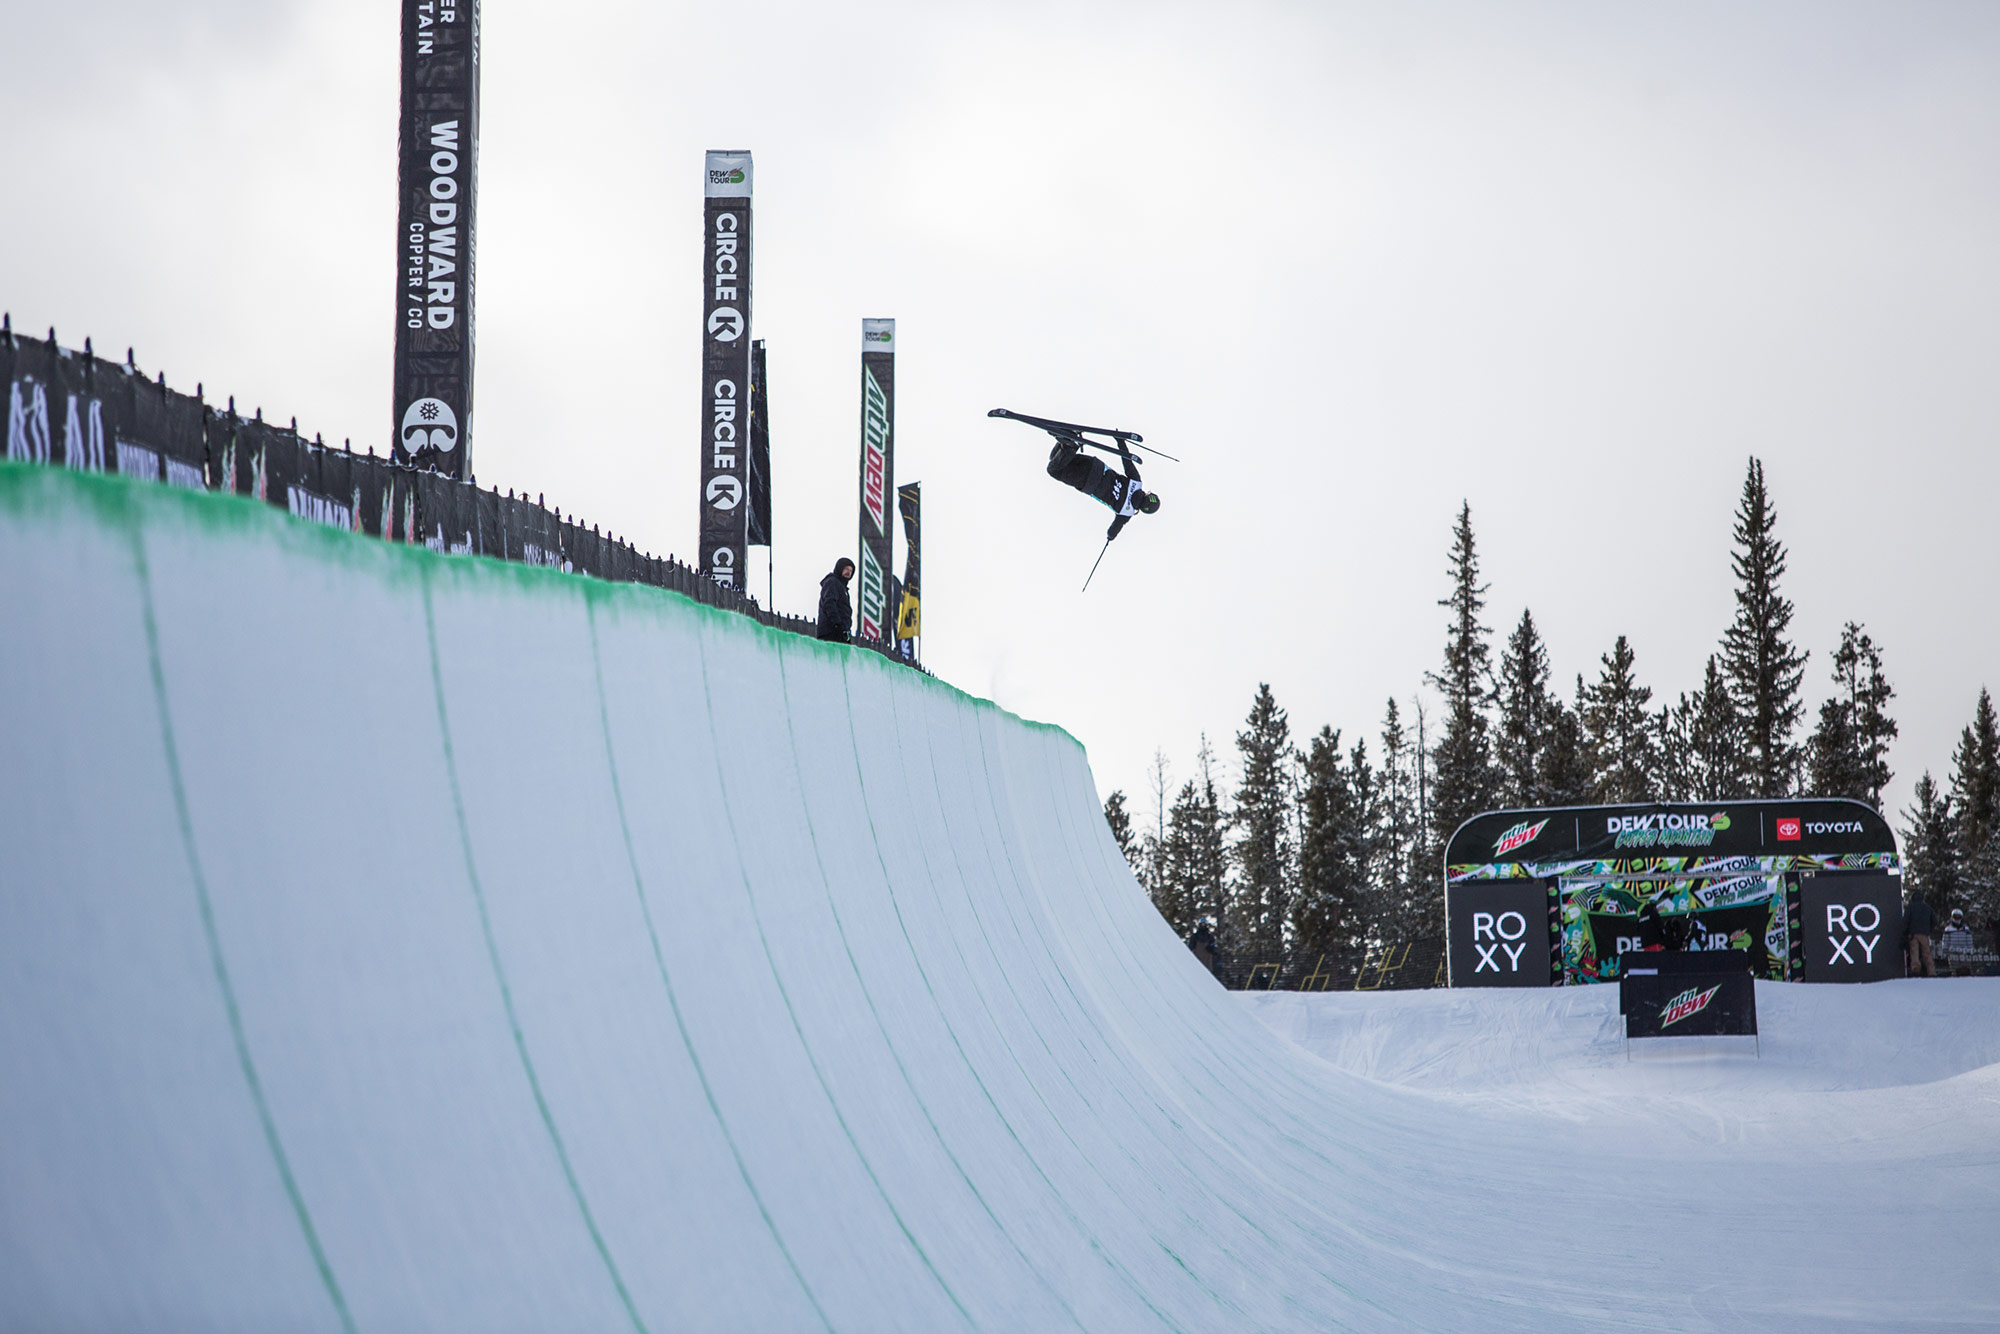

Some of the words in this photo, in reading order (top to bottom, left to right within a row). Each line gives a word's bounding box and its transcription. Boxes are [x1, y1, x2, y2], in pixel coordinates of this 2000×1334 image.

[709, 170, 728, 178] DEW
[427, 120, 458, 330] WOODWARD
[409, 222, 424, 287] COPPER
[715, 212, 738, 300] CIRCLE
[408, 307, 423, 329] CO
[709, 314, 738, 340] K
[713, 378, 737, 469] CIRCLE
[707, 482, 736, 508] K
[1805, 821, 1864, 834] TOYOTA
